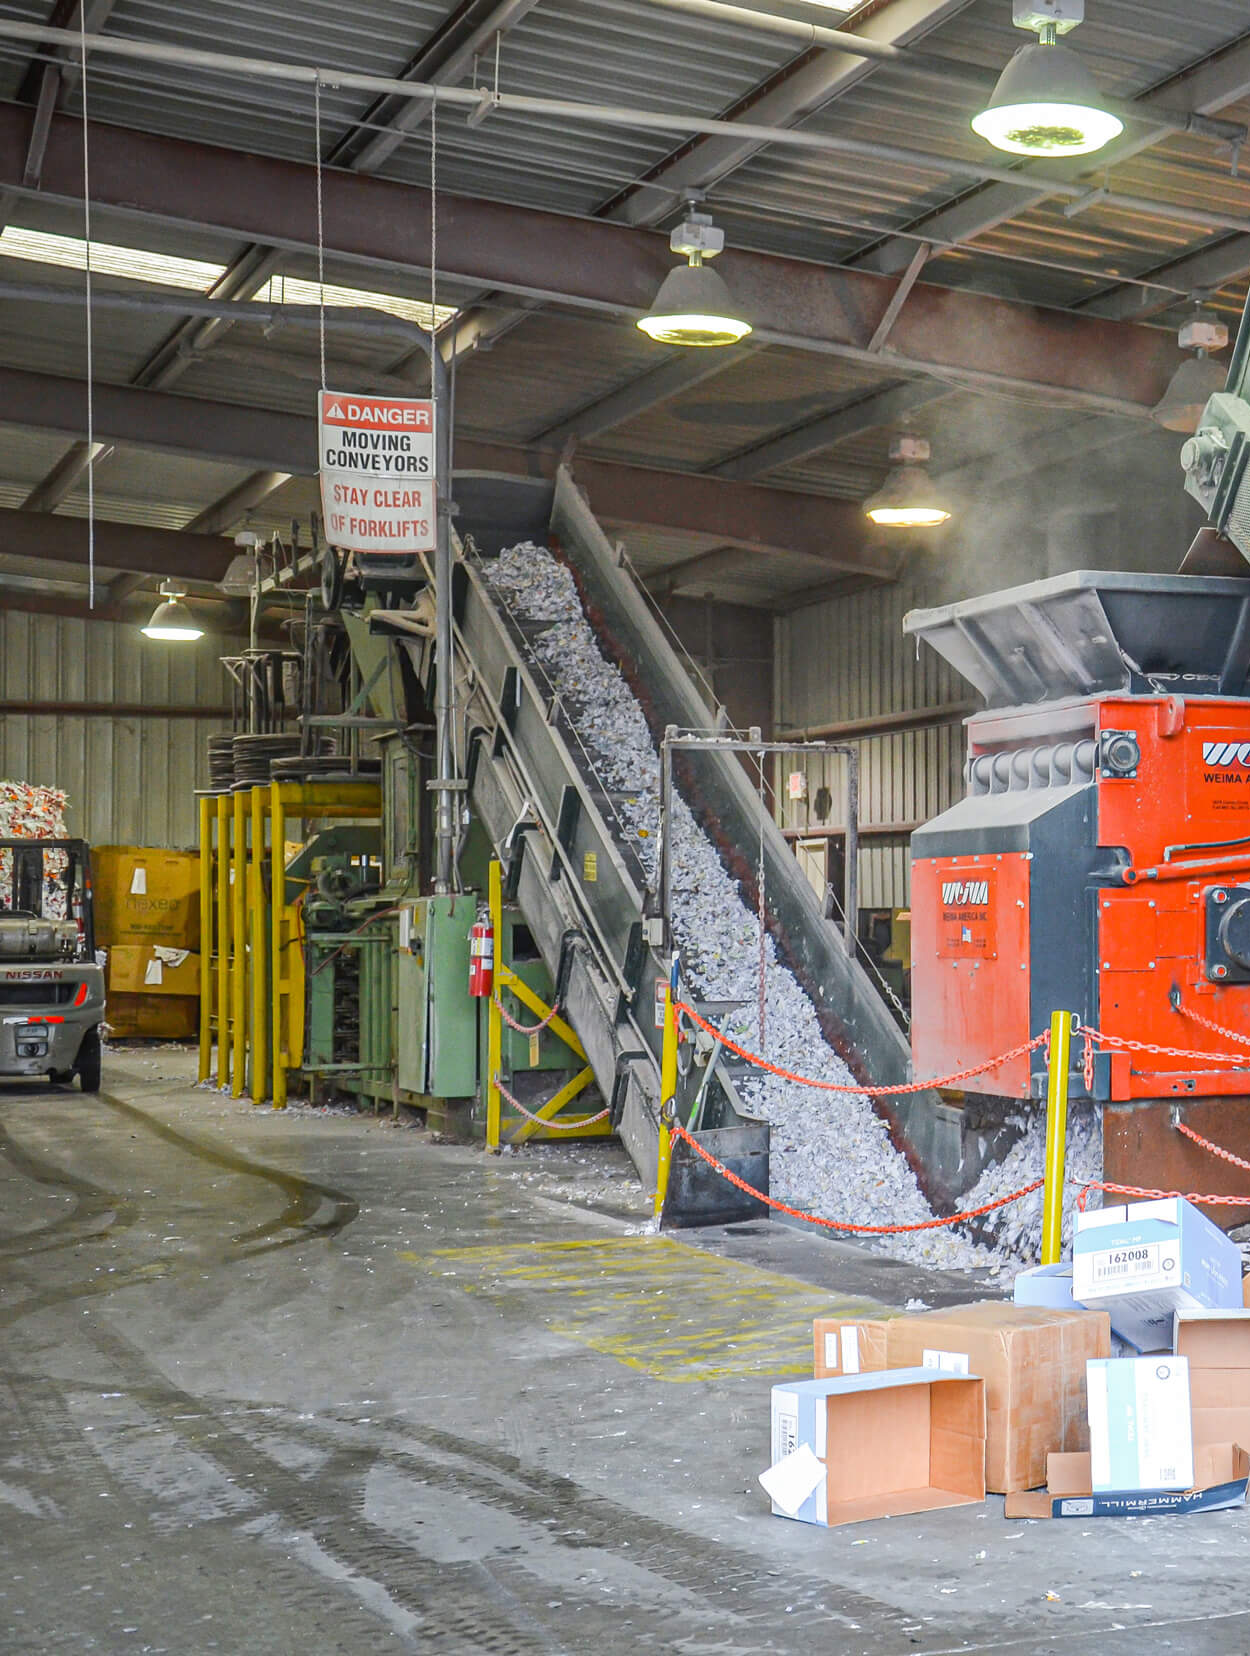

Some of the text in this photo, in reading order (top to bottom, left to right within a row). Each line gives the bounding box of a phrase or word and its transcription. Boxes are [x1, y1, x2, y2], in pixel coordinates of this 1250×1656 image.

[347, 405, 429, 425] DANGER
[342, 431, 411, 452] MOVING
[326, 449, 429, 473] CONVEYORS
[333, 484, 422, 508] STAY CLEAR
[331, 513, 429, 538] OF FORKLIFTS
[1204, 773, 1242, 784] WEIMA
[5, 970, 64, 980] NISSAN
[1108, 1249, 1149, 1265] 162008
[1099, 1493, 1202, 1508] HAMMERMILL
